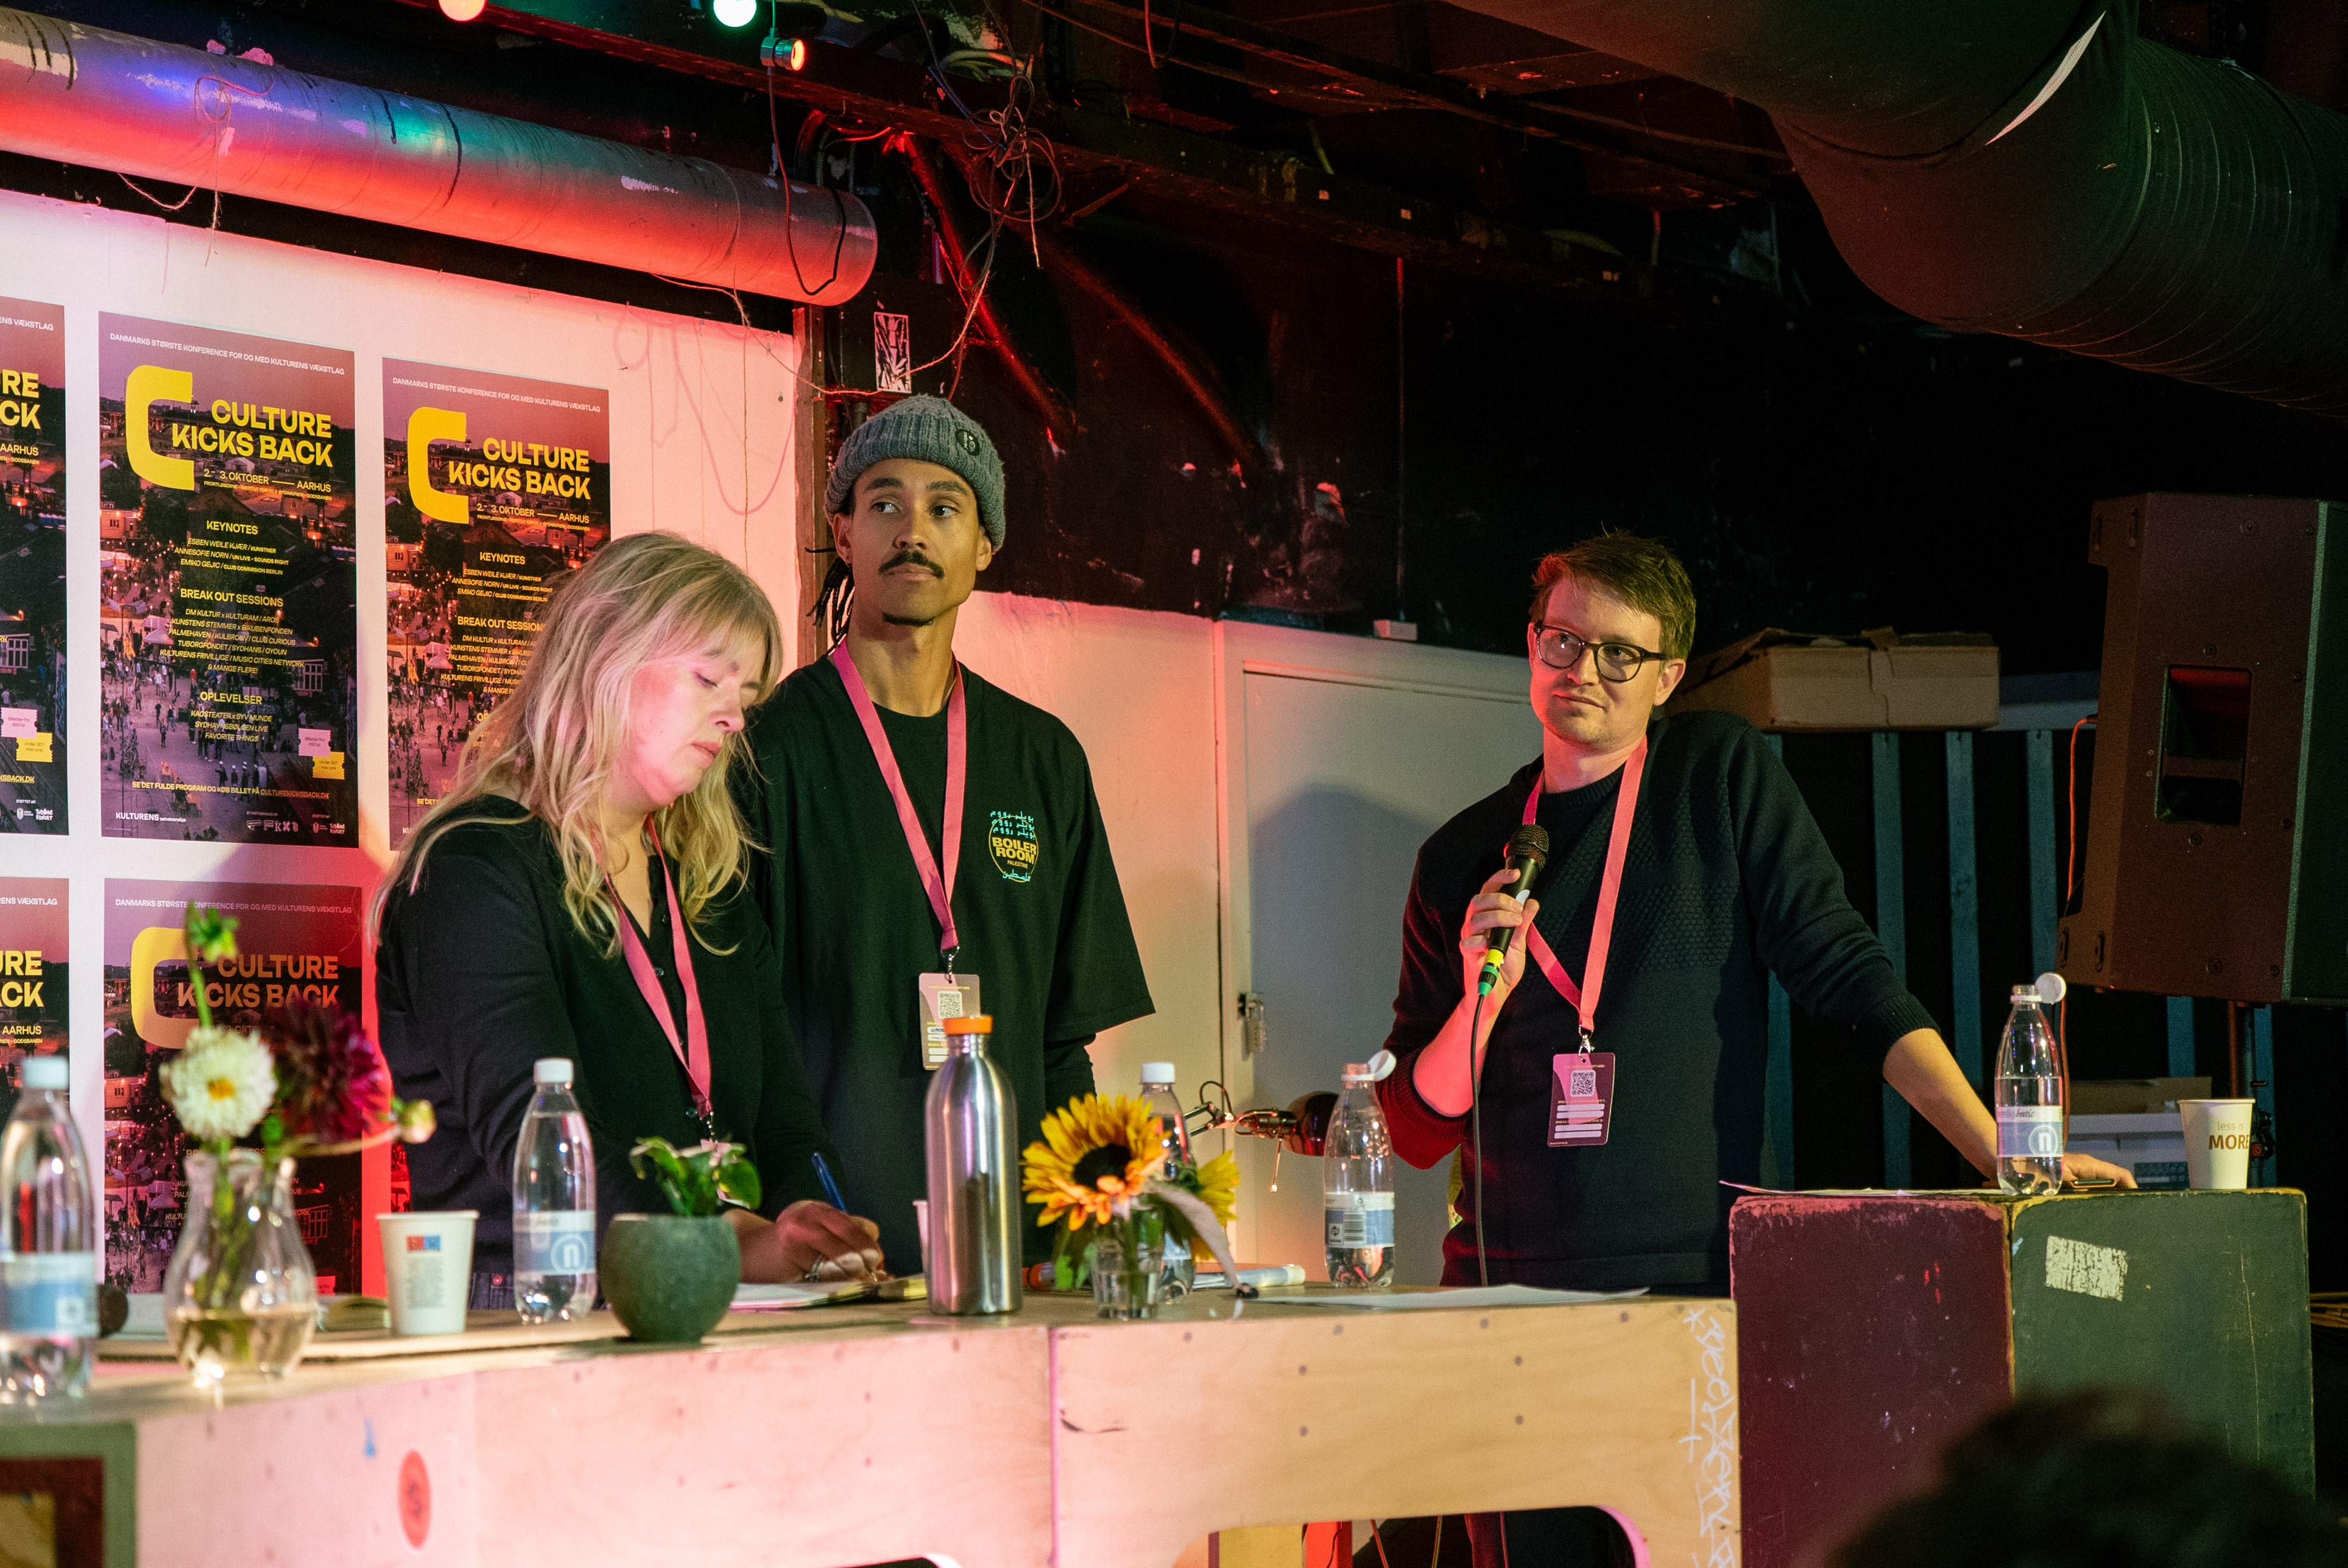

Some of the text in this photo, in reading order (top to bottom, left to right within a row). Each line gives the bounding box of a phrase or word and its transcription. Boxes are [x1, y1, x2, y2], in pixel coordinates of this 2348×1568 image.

[13, 318, 54, 331] VÆKSTLAG
[110, 333, 150, 345] DANMARKS
[152, 339, 182, 350] STØRSTE
[183, 344, 228, 357] KONFERENCE
[229, 351, 242, 360] FOR
[270, 358, 308, 370] KULTURENS
[309, 364, 345, 375] VÆKSTLAG
[393, 378, 428, 388] DANMARKS
[429, 382, 456, 392] STØRSTE
[457, 387, 497, 398] KONFERENCE
[535, 398, 568, 408] KULTURENS
[569, 402, 601, 413] VÆKSTLAG
[211, 399, 331, 438] CULTURE
[0, 443, 39, 456] AARHUS
[172, 423, 333, 467] KICKS BACK
[483, 437, 590, 473] CULTURE
[229, 472, 331, 493] OKTOBER AARHUS
[449, 461, 591, 500] KICKS BACK
[499, 506, 535, 518] OKTOBER
[559, 513, 590, 524] AARHUS
[206, 520, 258, 535] KEYNOTES
[188, 538, 209, 546] ESBEN
[174, 546, 210, 557] ANNESOFIE
[480, 552, 526, 565] KEYNOTES
[451, 578, 483, 587] ANNESOFIE
[181, 588, 283, 607] BREAK OUT SESSIONS
[225, 613, 258, 622] KULTURAM
[457, 616, 487, 627] BREAK
[488, 619, 506, 628] OUT
[171, 618, 293, 635] KUNSTENS STEMMER BIKUBENFONDEN
[169, 628, 211, 638] PALMEHAVEN
[269, 638, 295, 646] CURIOUS
[178, 640, 228, 650] TUBORGFONDET
[450, 644, 480, 653] KUNSTENS
[160, 649, 196, 658] KULTURENS
[197, 653, 229, 661] FRIVILLIGE
[273, 659, 304, 667] NETWORK
[448, 654, 486, 663] PALMEHAVEN
[457, 664, 501, 673] TUBORGFONDET
[200, 691, 262, 705] OPLEVELSER
[205, 733, 235, 741] FAVORITE
[116, 812, 159, 821] KULTURENS
[992, 837, 1037, 855] BOILER
[996, 846, 1034, 864] ROOM
[1007, 860, 1028, 869] PALESTINE
[218, 954, 339, 980] CULTURE
[0, 981, 44, 1007] CK
[178, 982, 261, 1008] KCKS
[2, 1025, 41, 1035] AARHUS
[2217, 1122, 2236, 1131] less
[2209, 1134, 2249, 1150] MORE
